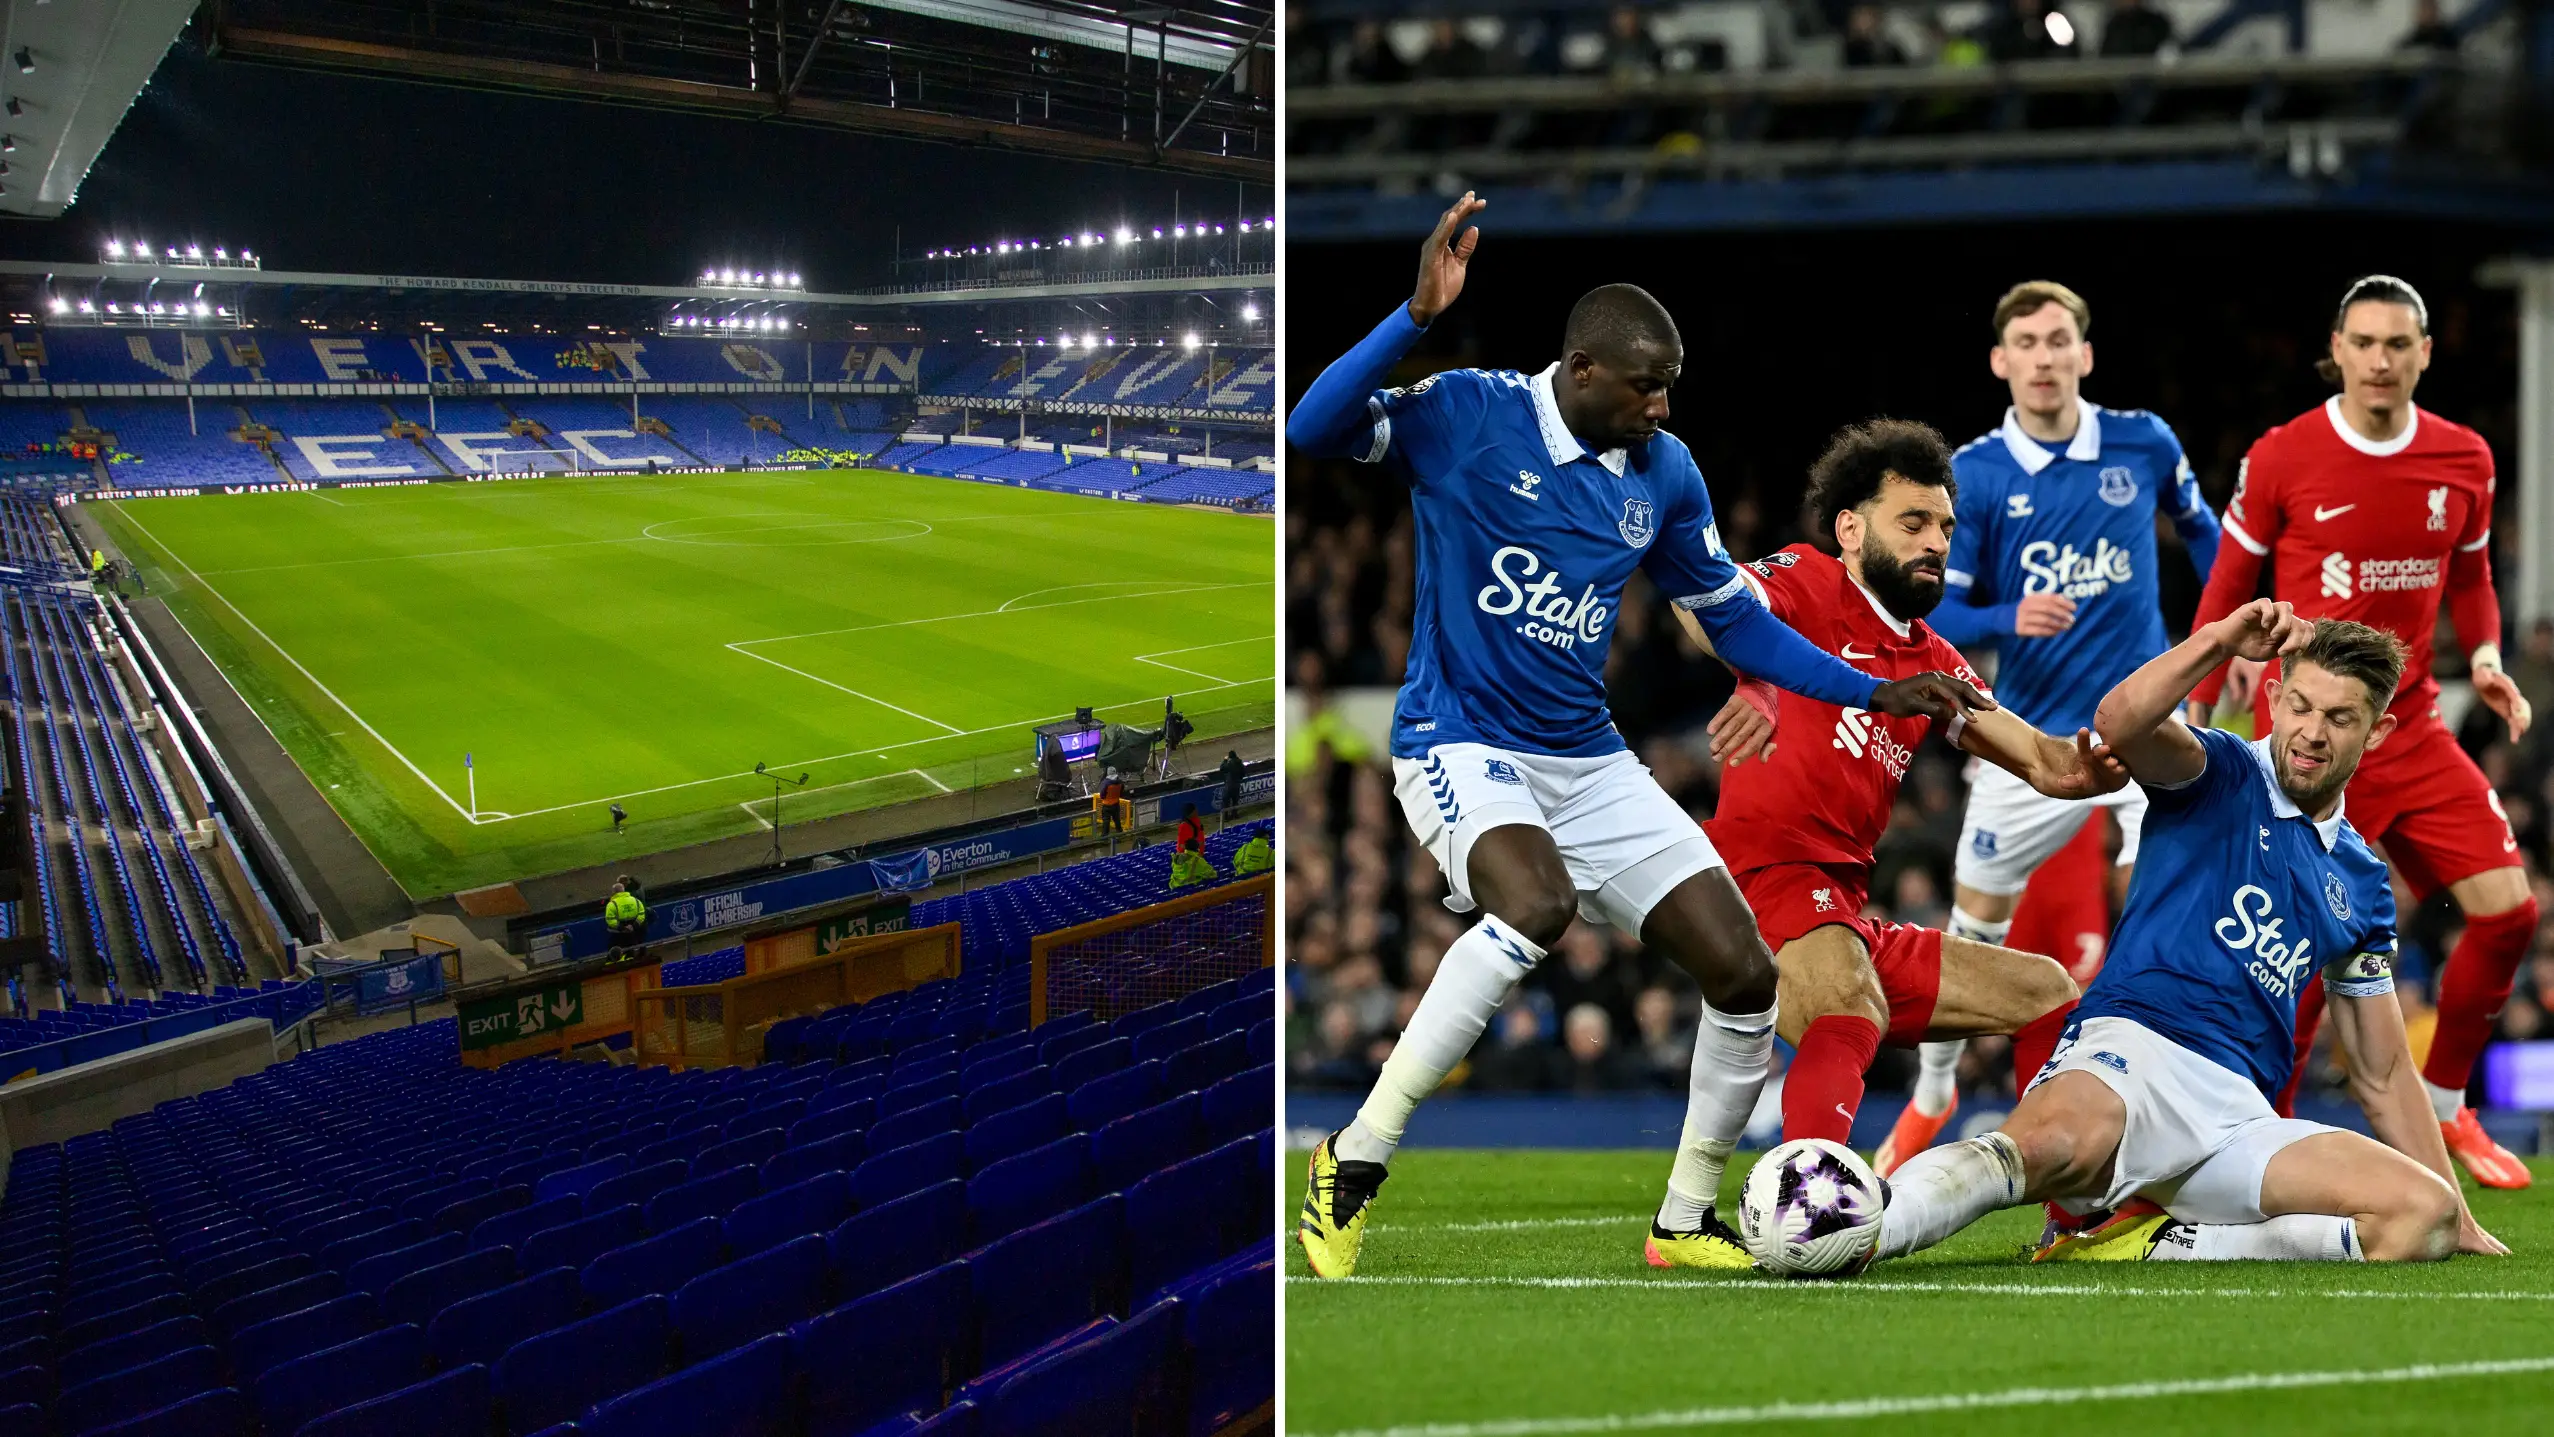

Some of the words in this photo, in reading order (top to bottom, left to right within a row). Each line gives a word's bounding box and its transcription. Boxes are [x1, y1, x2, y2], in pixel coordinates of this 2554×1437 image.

[378, 276, 401, 286] THE
[407, 278, 457, 289] HOWARD
[463, 280, 515, 291] KENDALL
[520, 282, 572, 293] GWLADYS
[577, 284, 615, 294] STREET
[621, 286, 641, 295] END
[292, 430, 673, 477] EFC
[169, 488, 200, 497] STOPS
[2020, 537, 2133, 596] Stake
[1477, 546, 1607, 643] Stake
[1515, 621, 1575, 650] .com
[942, 841, 992, 863] Everton
[942, 862, 950, 873] in
[951, 860, 965, 871] the
[966, 849, 1011, 867] Community
[705, 901, 763, 928] MEMBERSHIP
[874, 916, 906, 935] EXIT
[467, 1012, 511, 1036] EXIT
